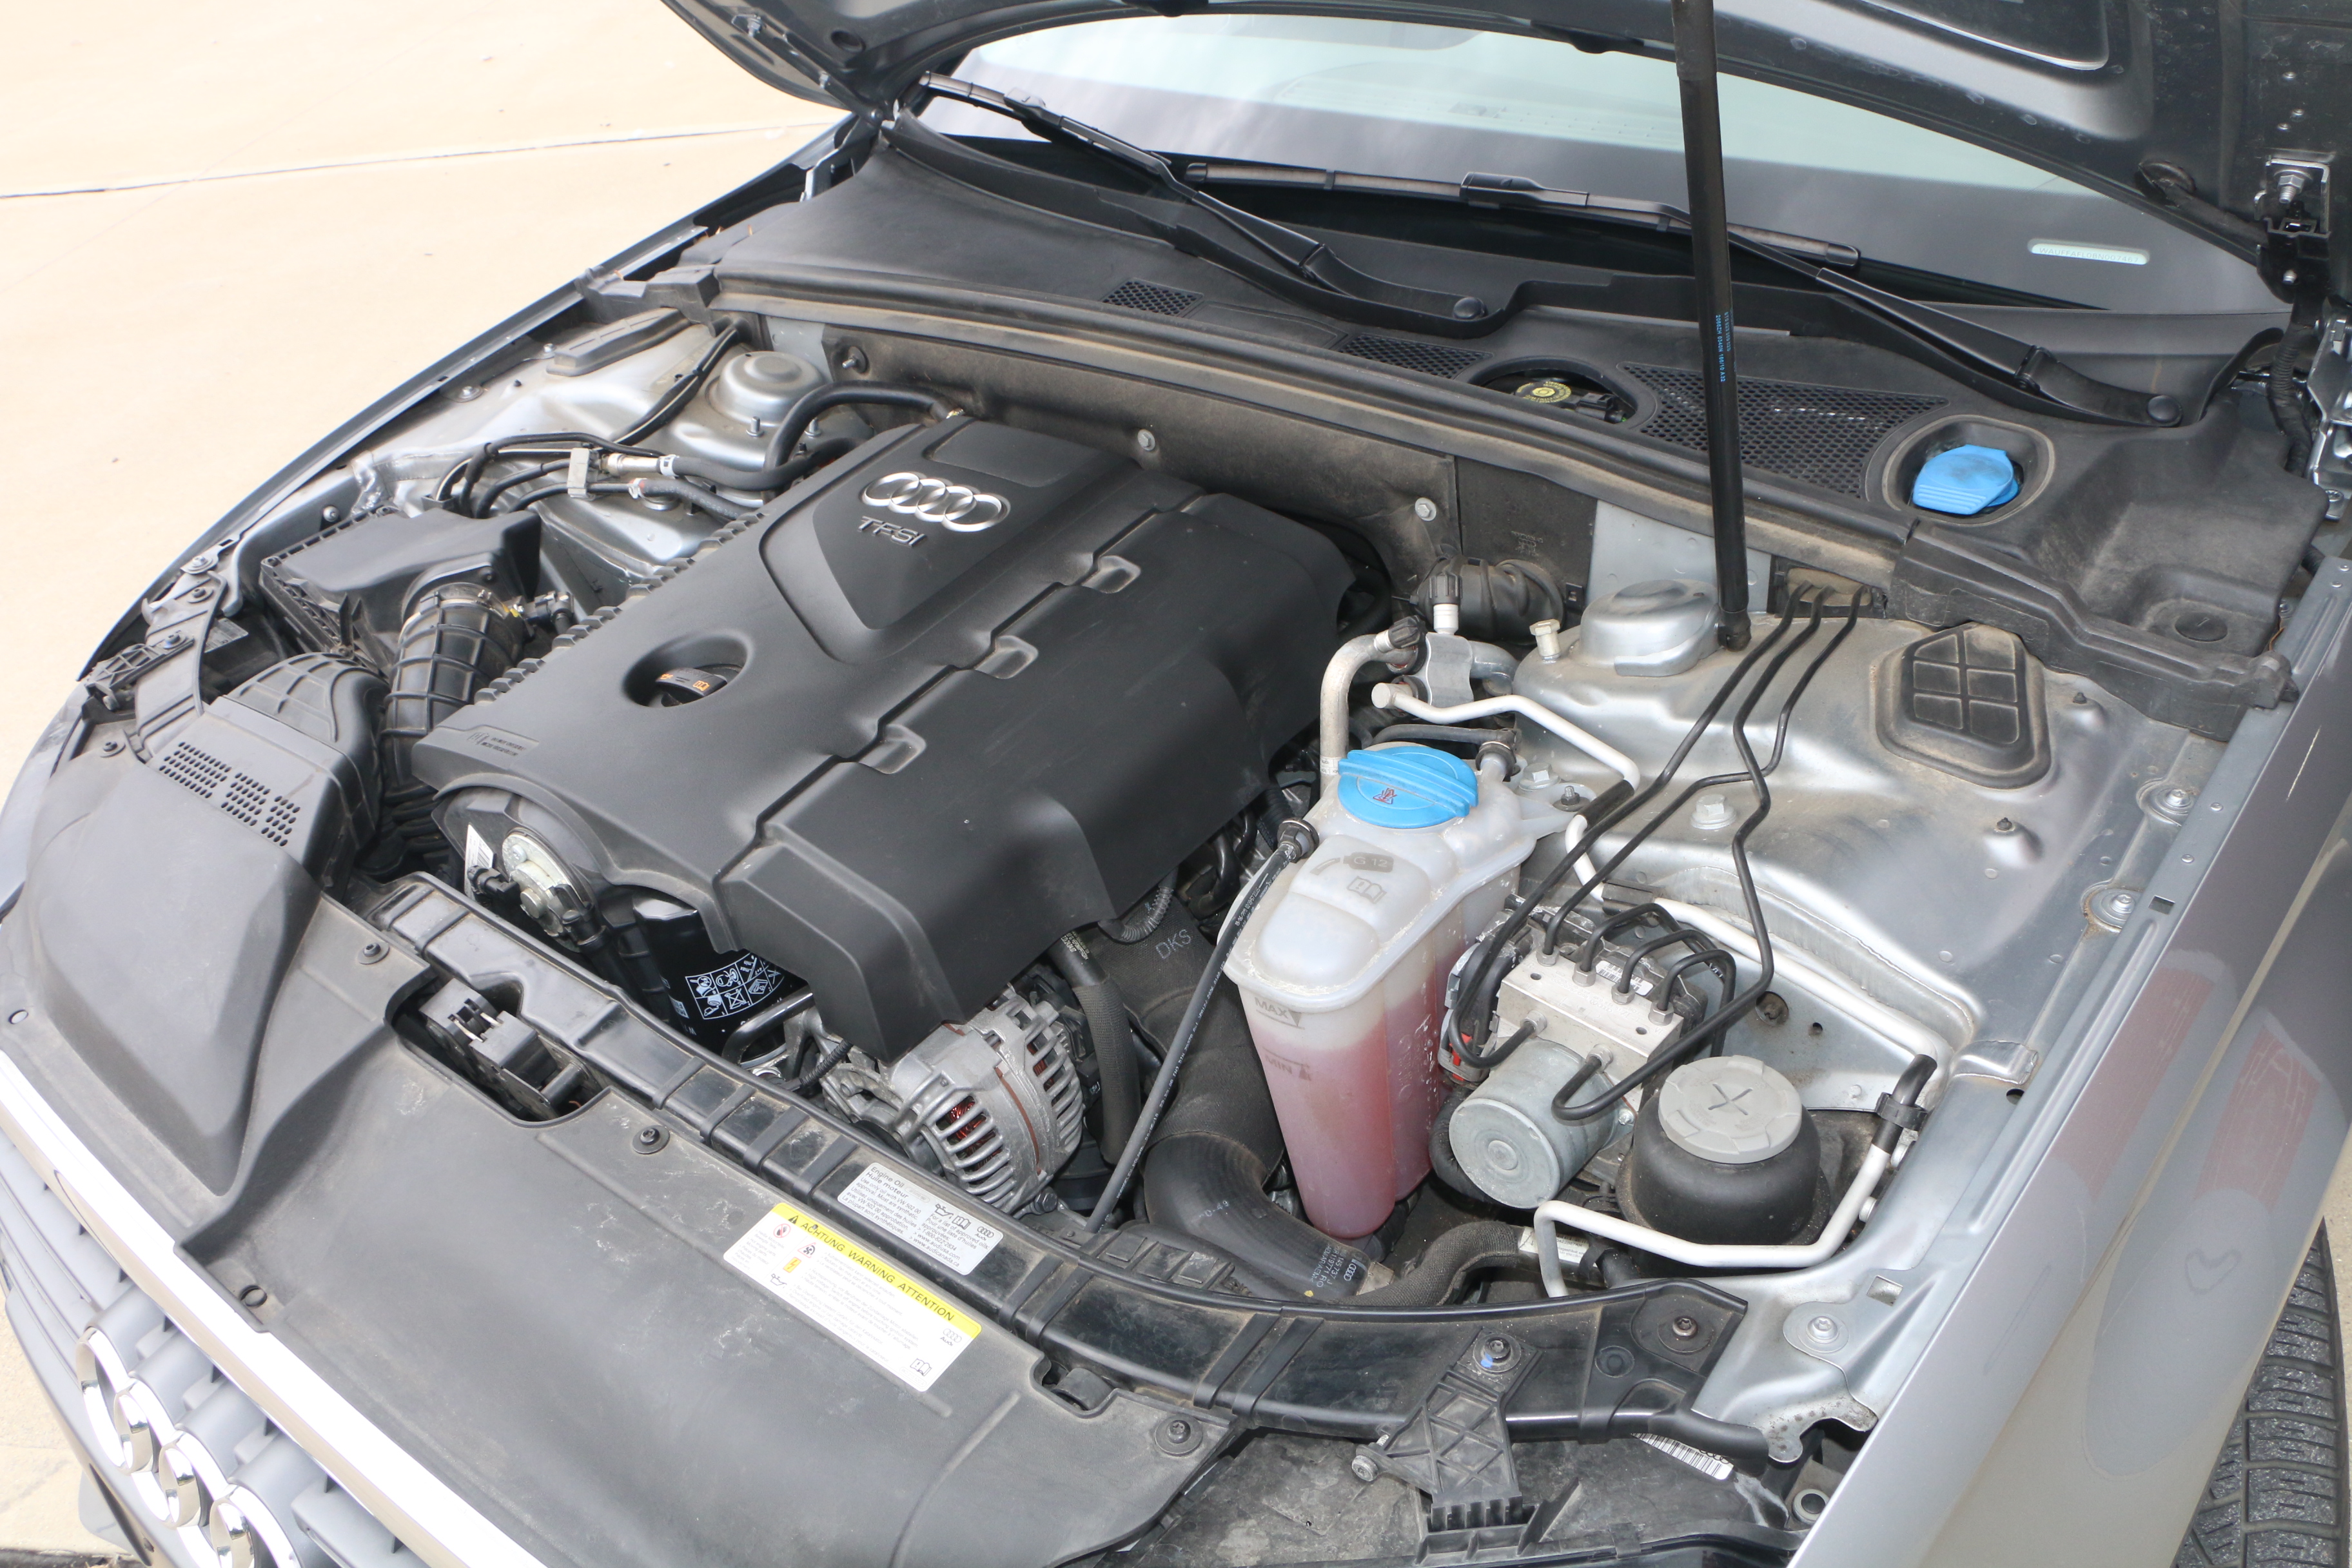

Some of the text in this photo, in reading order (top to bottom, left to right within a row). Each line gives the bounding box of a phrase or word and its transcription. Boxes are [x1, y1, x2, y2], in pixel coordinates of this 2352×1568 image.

[2039, 248, 2139, 263] WAUFFAFL0BN007467
[858, 516, 927, 547] TFSI
[1354, 856, 1387, 867] G 12
[1155, 929, 1191, 959] DKS
[1254, 997, 1288, 1019] MAX
[1265, 1054, 1292, 1074] MIN
[865, 1171, 884, 1184] Huile
[882, 1182, 909, 1199] moteur
[869, 1166, 905, 1188] Engine Oil
[855, 1181, 877, 1196] approval.
[876, 1193, 890, 1202] Most
[895, 1204, 920, 1220] synthetic.
[868, 1182, 881, 1191] only
[885, 1191, 897, 1200] with
[896, 1197, 906, 1206] VW
[846, 1191, 858, 1199] avec
[856, 1197, 867, 1205] VW
[879, 1210, 910, 1231] approbation.
[847, 1198, 866, 1211] plupart
[863, 1208, 876, 1217] sont
[850, 1186, 918, 1228] Utilisez uniquement des huiles
[919, 1222, 951, 1242] approuvées:
[921, 1228, 958, 1251] 1-800-822-2834
[925, 1217, 978, 1250] Pour une liste d'huiles
[954, 1228, 980, 1244] approved
[977, 1240, 991, 1250] oils:
[974, 1232, 988, 1241] Audi
[912, 1237, 961, 1268] www.audicanada.ca
[916, 1232, 961, 1260] www.audiusa.com
[799, 1221, 956, 1322] ACHTUNG WARNING ATTENTION
[1330, 1266, 1340, 1279] 737
[939, 1335, 955, 1347] Audi
